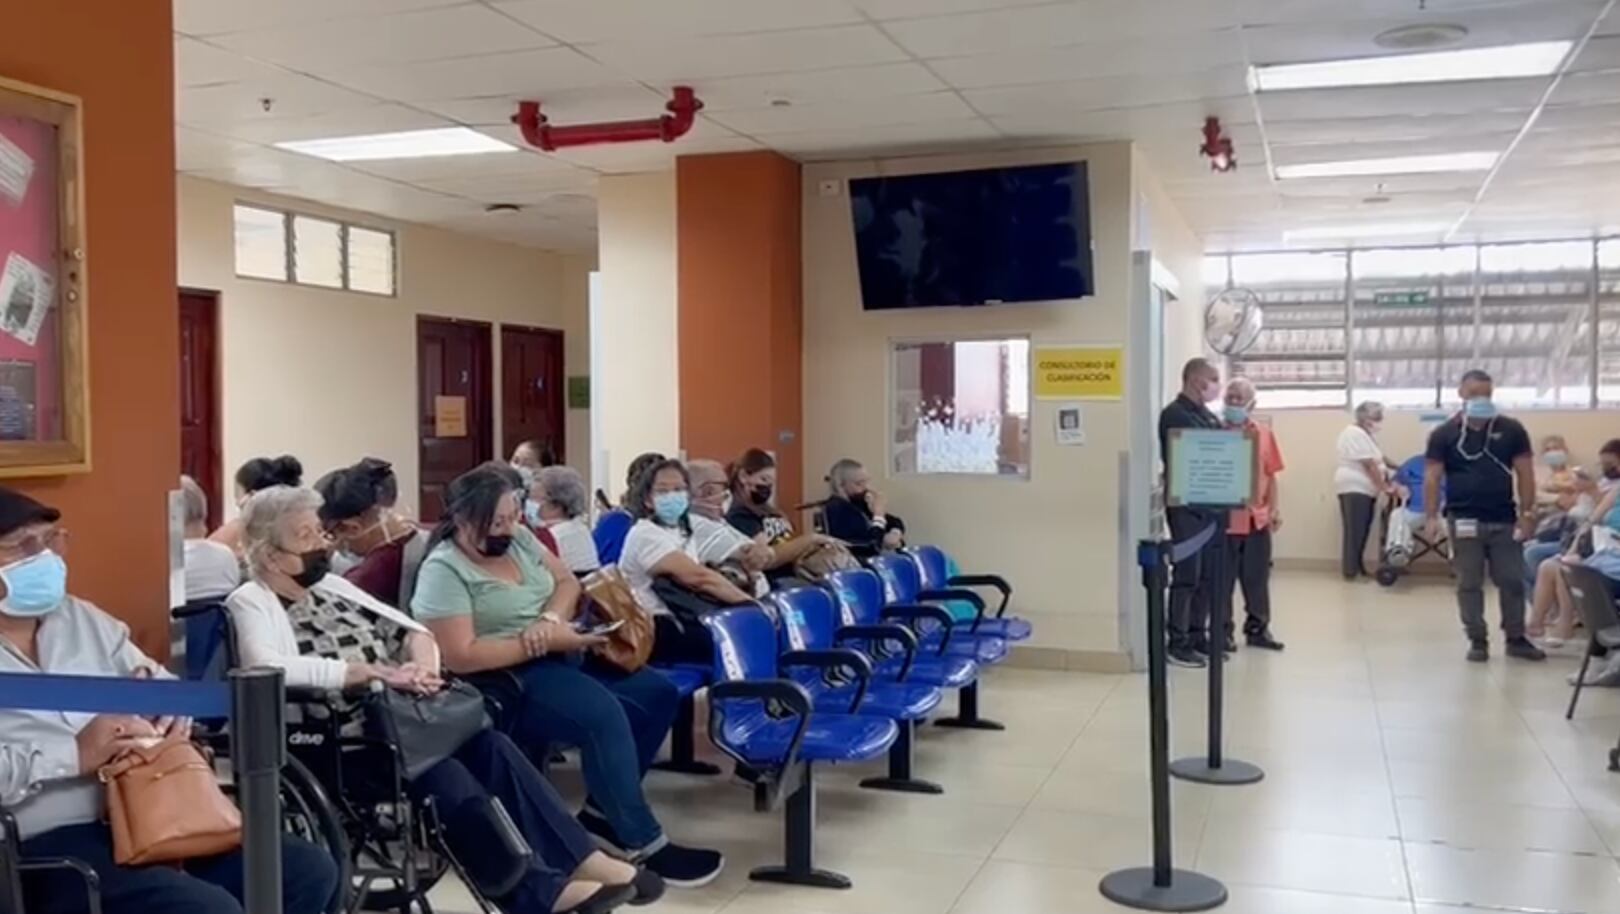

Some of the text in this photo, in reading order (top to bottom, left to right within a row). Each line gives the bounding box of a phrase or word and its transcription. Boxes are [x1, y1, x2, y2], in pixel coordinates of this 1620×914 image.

[1039, 361, 1115, 369] CONSULTORIO DE
[1046, 372, 1111, 382] CLASIFICACIÓN
